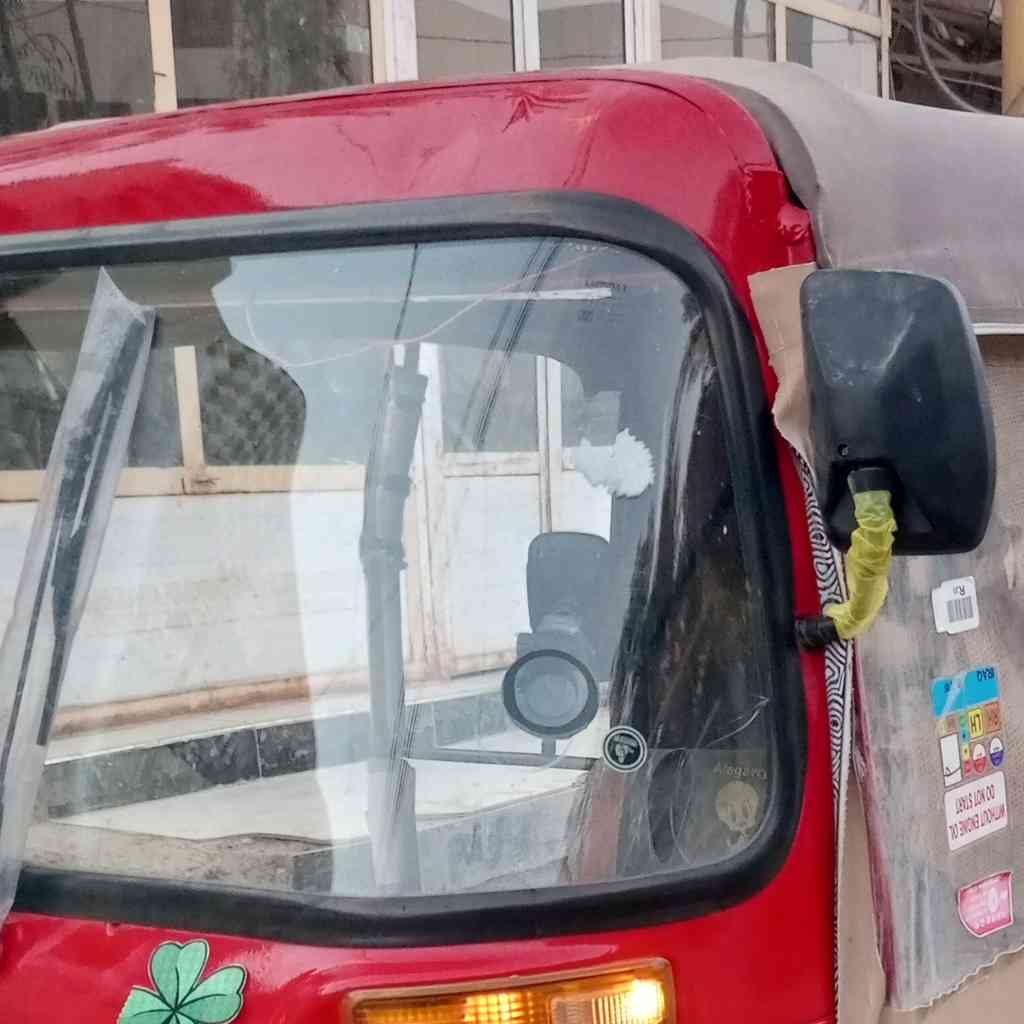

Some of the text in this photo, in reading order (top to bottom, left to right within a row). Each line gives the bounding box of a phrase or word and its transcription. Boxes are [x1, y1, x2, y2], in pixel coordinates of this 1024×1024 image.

[970, 714, 982, 734] LH
[955, 784, 995, 815] DO NOT START
[959, 814, 980, 836] ENGINE
[980, 804, 1005, 827] WITHOUT
